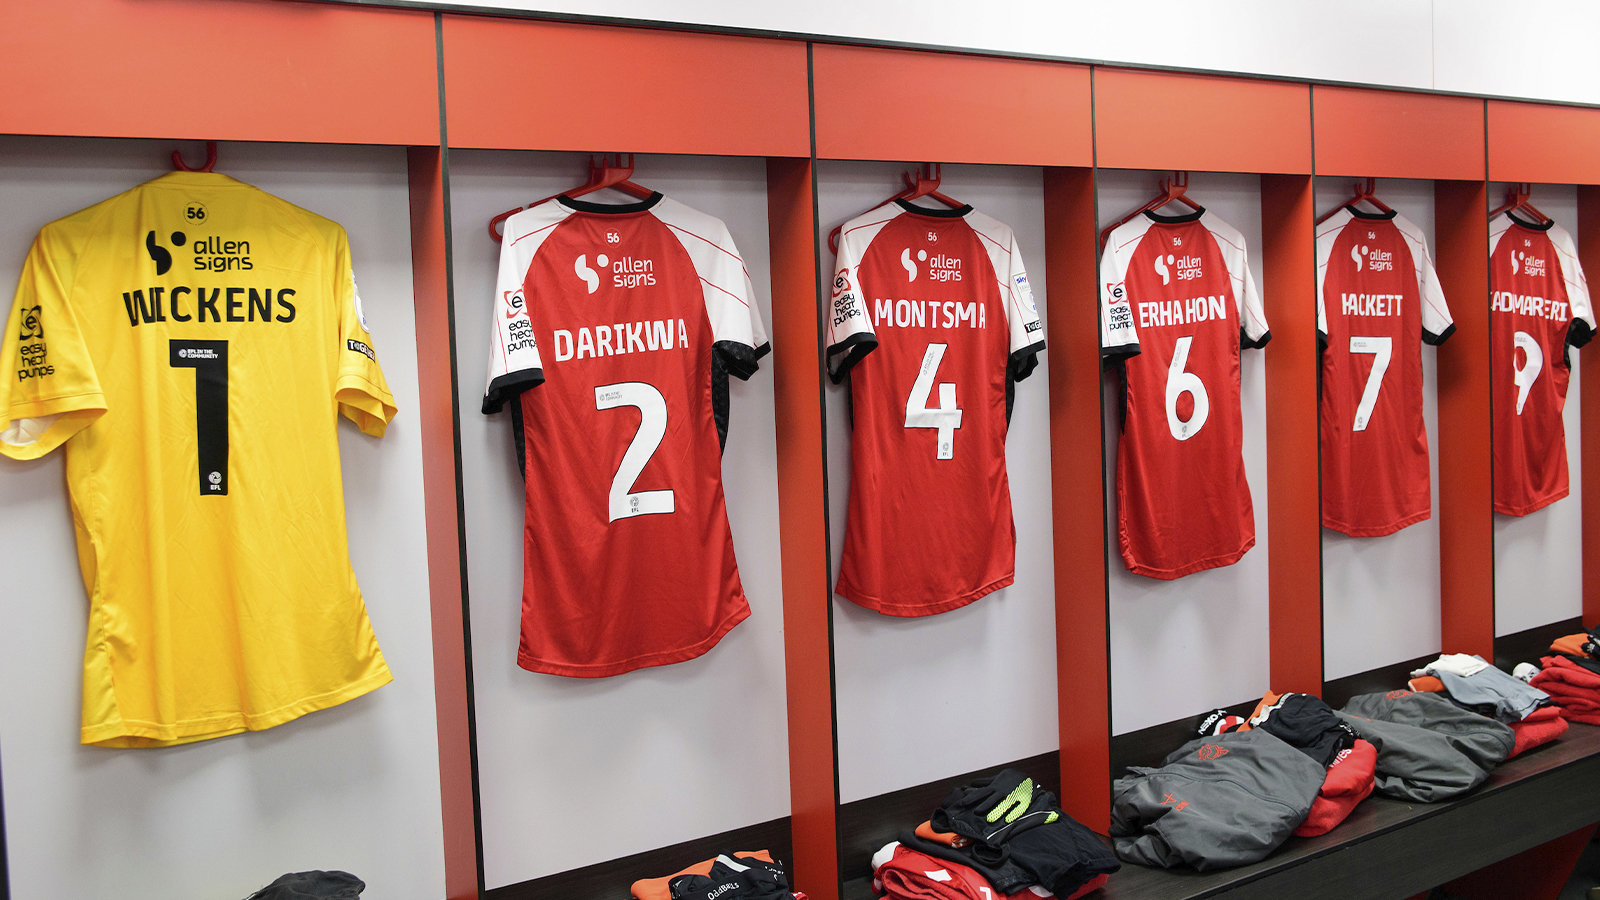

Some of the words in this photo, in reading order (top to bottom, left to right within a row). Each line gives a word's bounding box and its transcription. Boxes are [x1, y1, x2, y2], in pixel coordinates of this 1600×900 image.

[187, 207, 206, 220] 56
[607, 233, 620, 243] 56
[927, 232, 938, 242] 56
[1173, 237, 1182, 246] 56
[1368, 231, 1376, 240] 56
[1524, 239, 1531, 247] 56
[193, 236, 250, 255] allen
[929, 254, 962, 269] allen
[1369, 248, 1393, 261] allen
[194, 256, 254, 272] signs
[613, 256, 653, 274] allen
[1176, 255, 1202, 270] allen
[1369, 261, 1393, 272] signs
[929, 269, 962, 282] signs
[1177, 267, 1203, 281] signs
[1524, 265, 1546, 277] signs
[613, 273, 656, 289] signs
[122, 285, 297, 327] WICKENS
[833, 293, 855, 308] easy
[874, 298, 986, 330] MONTSMA
[1138, 295, 1226, 328] ERHAHON
[507, 339, 537, 355] pump
[553, 318, 689, 362] DARIKWA
[20, 343, 47, 356] easy
[21, 354, 46, 368] heat
[1513, 331, 1544, 416] 9
[1165, 336, 1210, 441] 6
[1350, 336, 1393, 431] 7
[904, 343, 963, 460] 4
[169, 339, 229, 496] 1
[594, 381, 675, 523] 2
